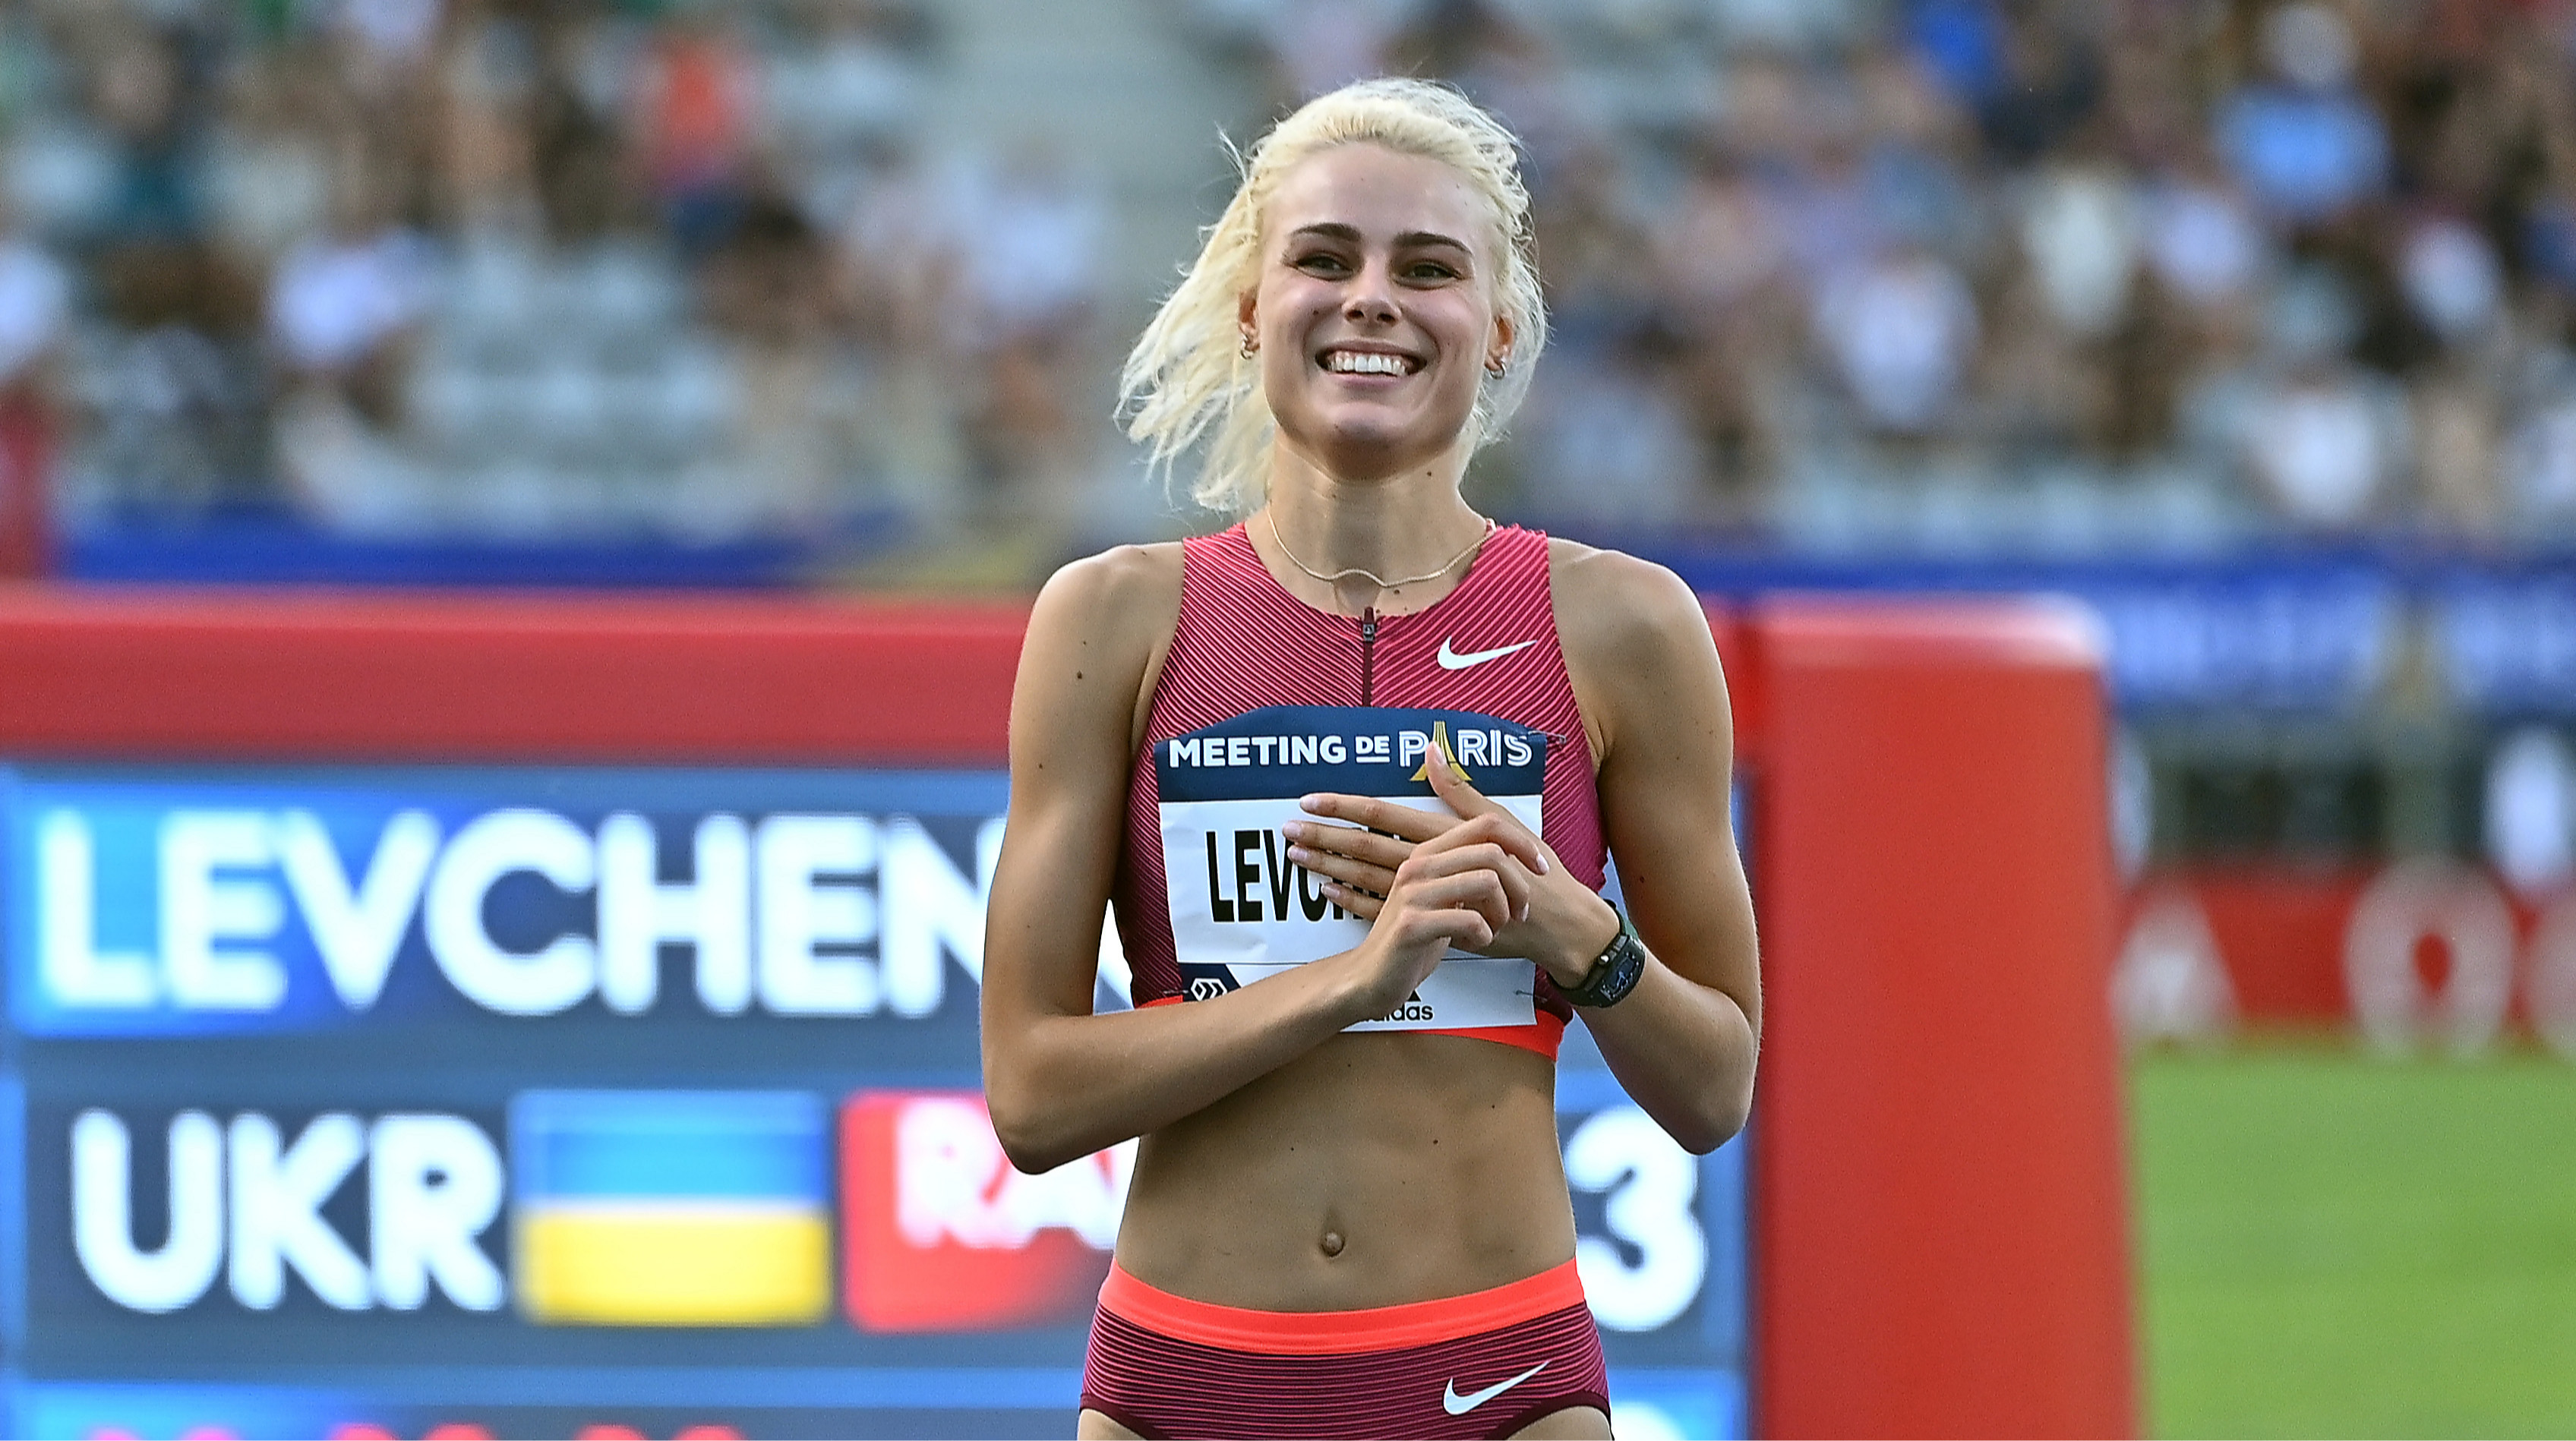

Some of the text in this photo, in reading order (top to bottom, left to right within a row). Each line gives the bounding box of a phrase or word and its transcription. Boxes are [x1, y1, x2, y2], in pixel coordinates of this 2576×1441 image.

[1169, 735, 1346, 768] MEETING
[1356, 736, 1390, 762] DE
[38, 808, 1135, 1016] LEVCHEN
[71, 1108, 505, 1313] UKR
[1563, 1105, 1709, 1332] 3
